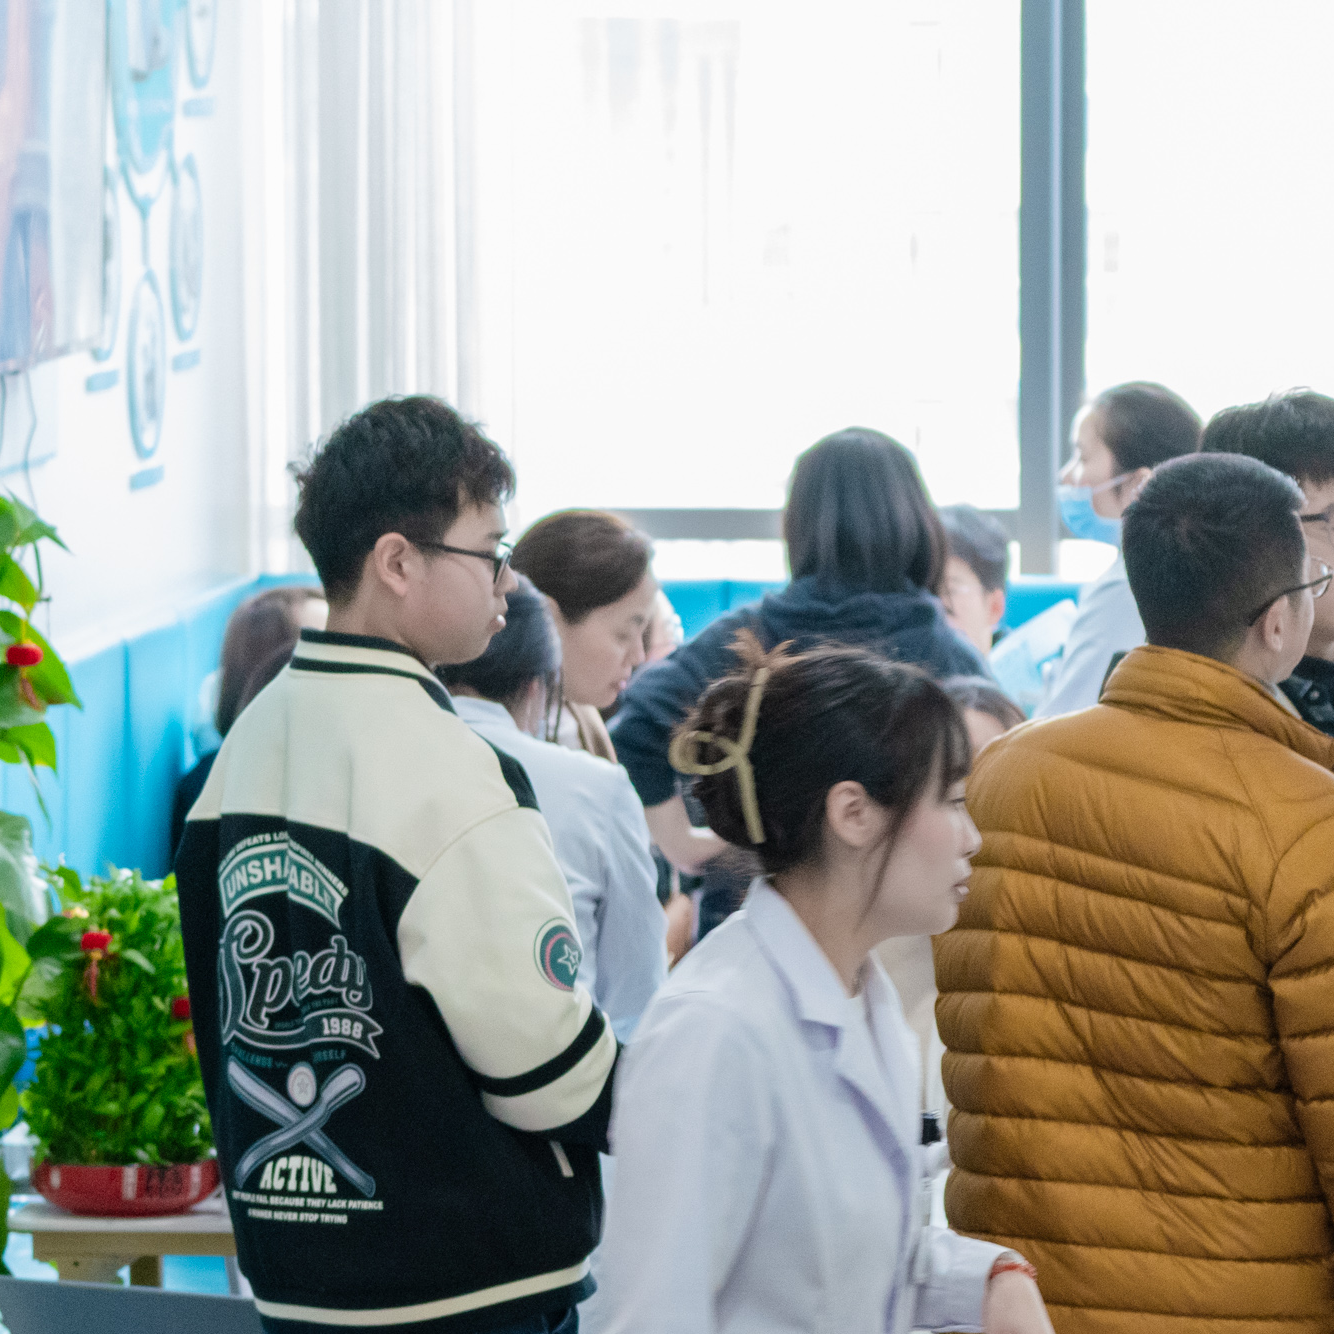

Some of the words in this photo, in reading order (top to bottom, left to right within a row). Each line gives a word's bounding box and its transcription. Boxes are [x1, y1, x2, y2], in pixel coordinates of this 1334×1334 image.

[322, 1017, 364, 1040] 1988
[259, 1155, 337, 1194] ACTIVE
[306, 1197, 327, 1208] THEY
[327, 1199, 347, 1209] LACK
